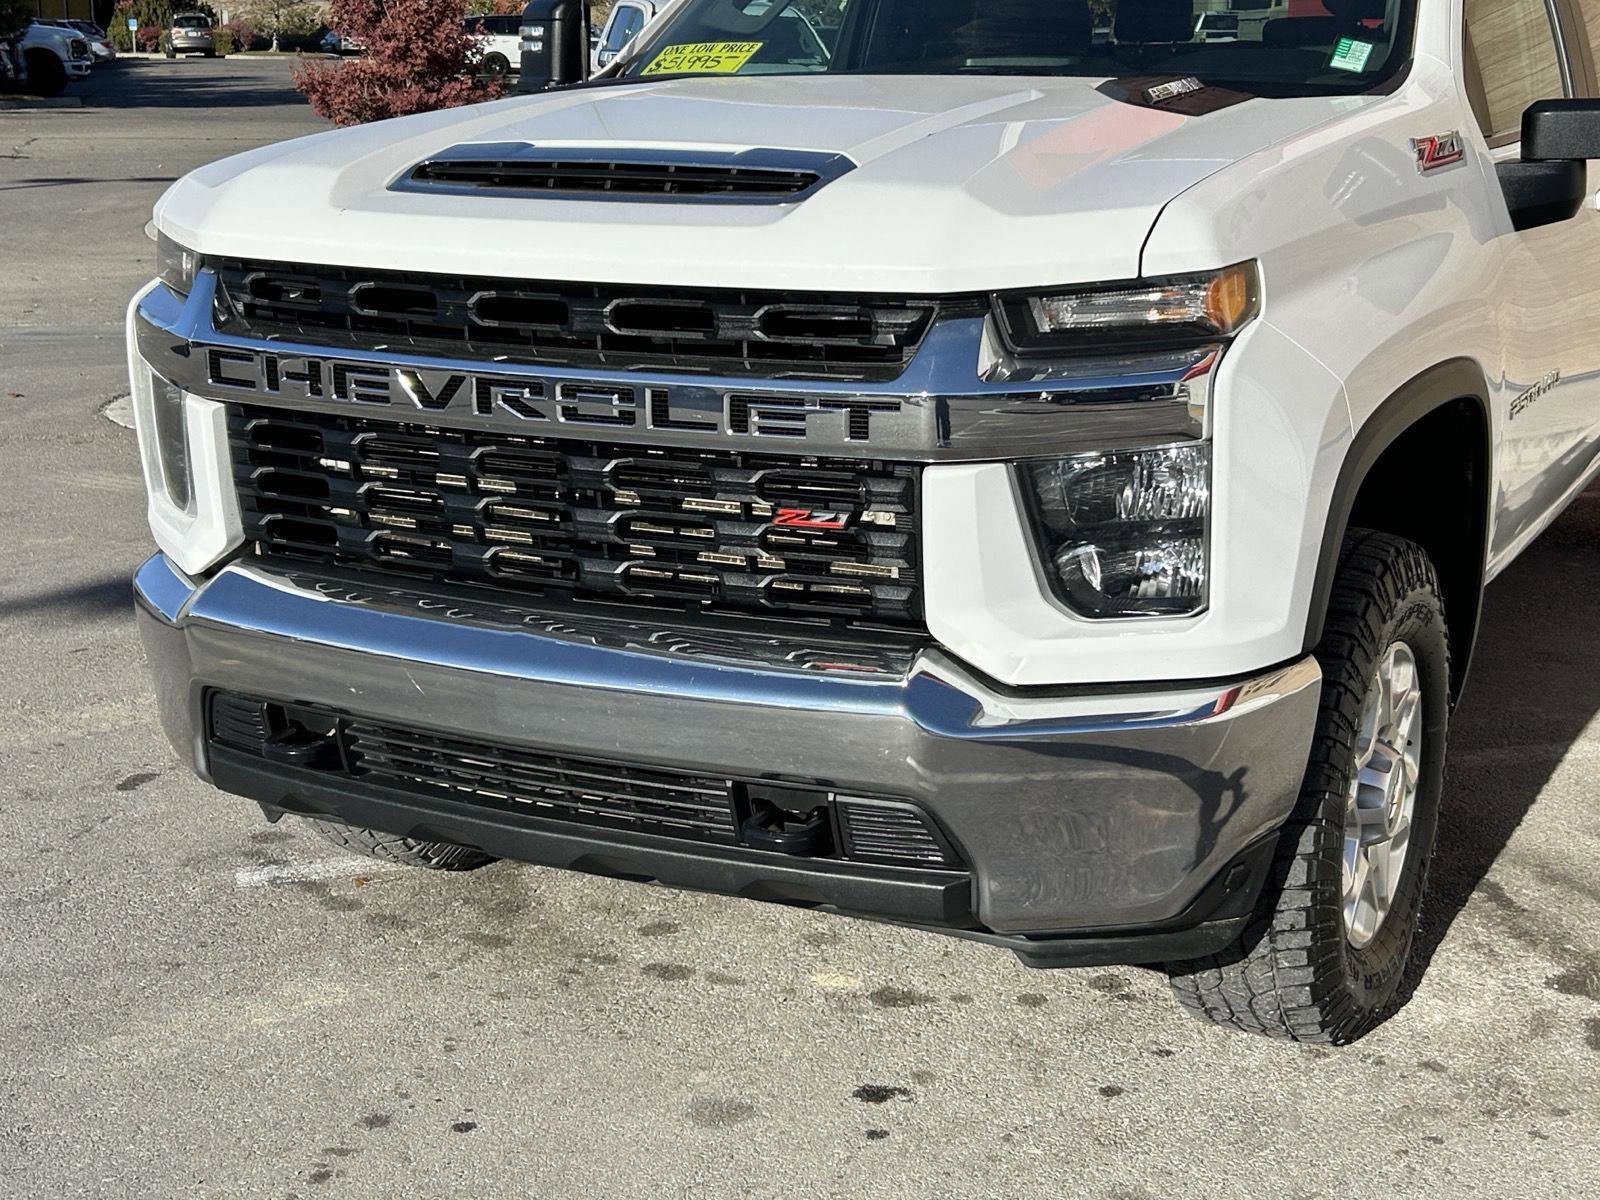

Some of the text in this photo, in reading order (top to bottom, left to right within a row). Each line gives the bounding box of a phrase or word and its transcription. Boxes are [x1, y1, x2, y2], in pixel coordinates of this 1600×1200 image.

[663, 43, 759, 56] ONE LOW PRICE
[1408, 129, 1464, 172] Z71
[203, 347, 902, 443] CHEVROLET
[772, 507, 851, 529] Z71
